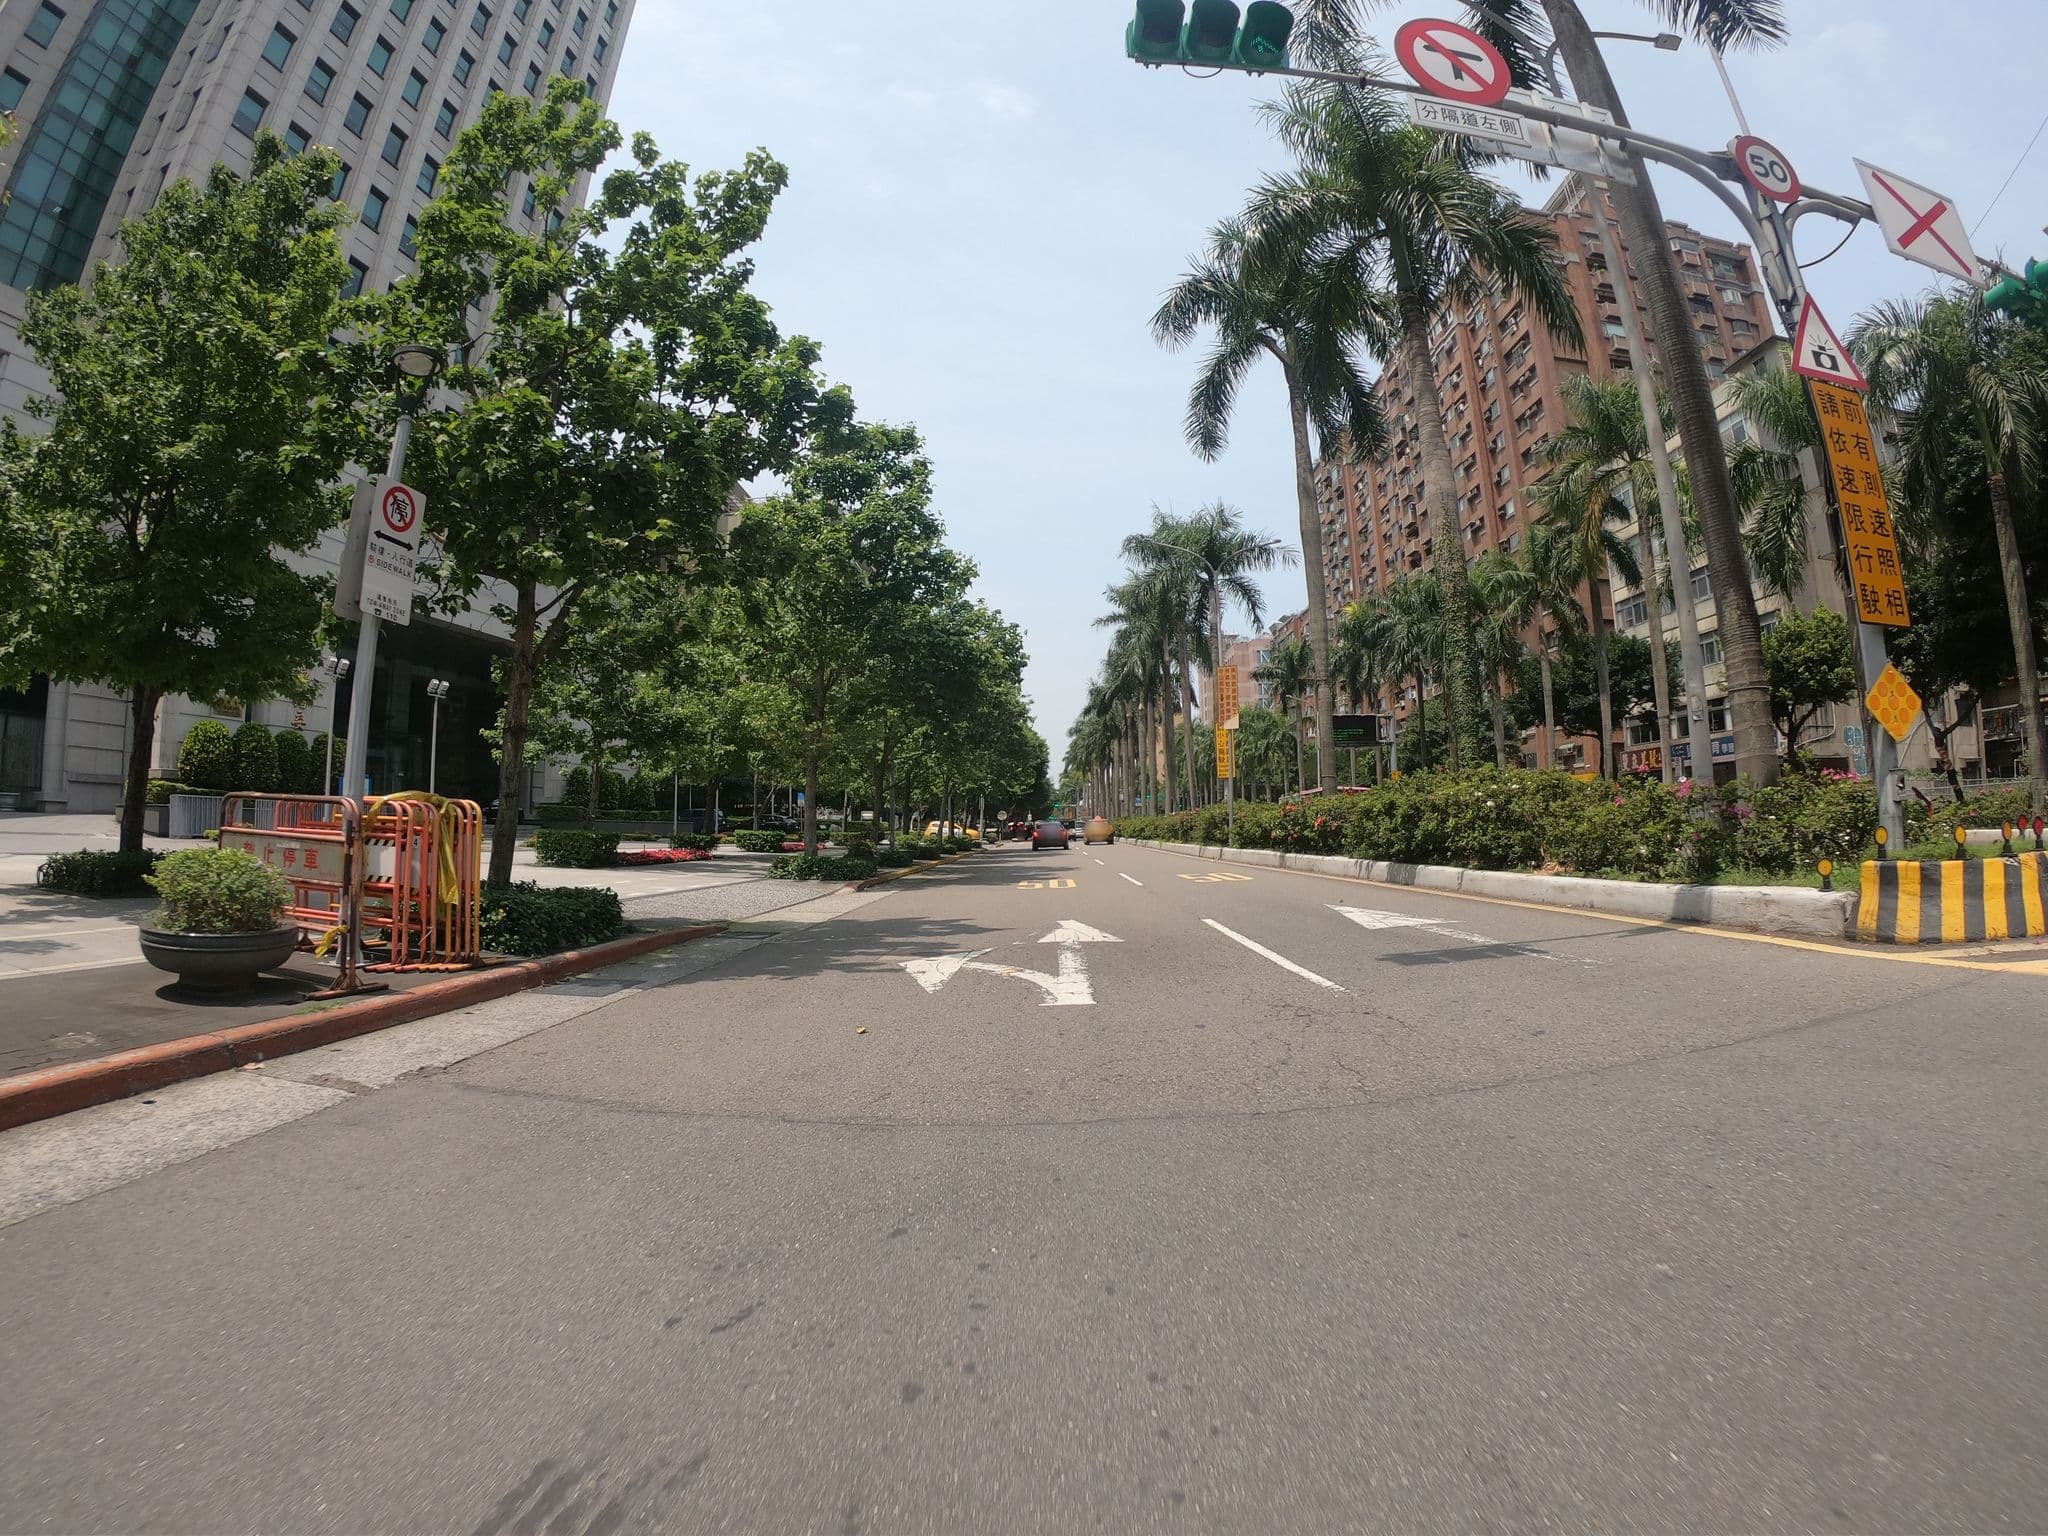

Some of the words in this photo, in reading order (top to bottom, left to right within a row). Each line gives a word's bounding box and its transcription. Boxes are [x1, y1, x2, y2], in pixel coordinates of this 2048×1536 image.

[1421, 104, 1518, 136] 分隔道左側
[1749, 153, 1788, 183] 50
[390, 495, 410, 522] 停
[1817, 388, 1883, 615] 請依速限行駛
[1840, 396, 1905, 617] 前有測速照相
[376, 558, 412, 578] SIDEWALK
[1016, 878, 1077, 890] 50
[1176, 872, 1255, 883] 50
